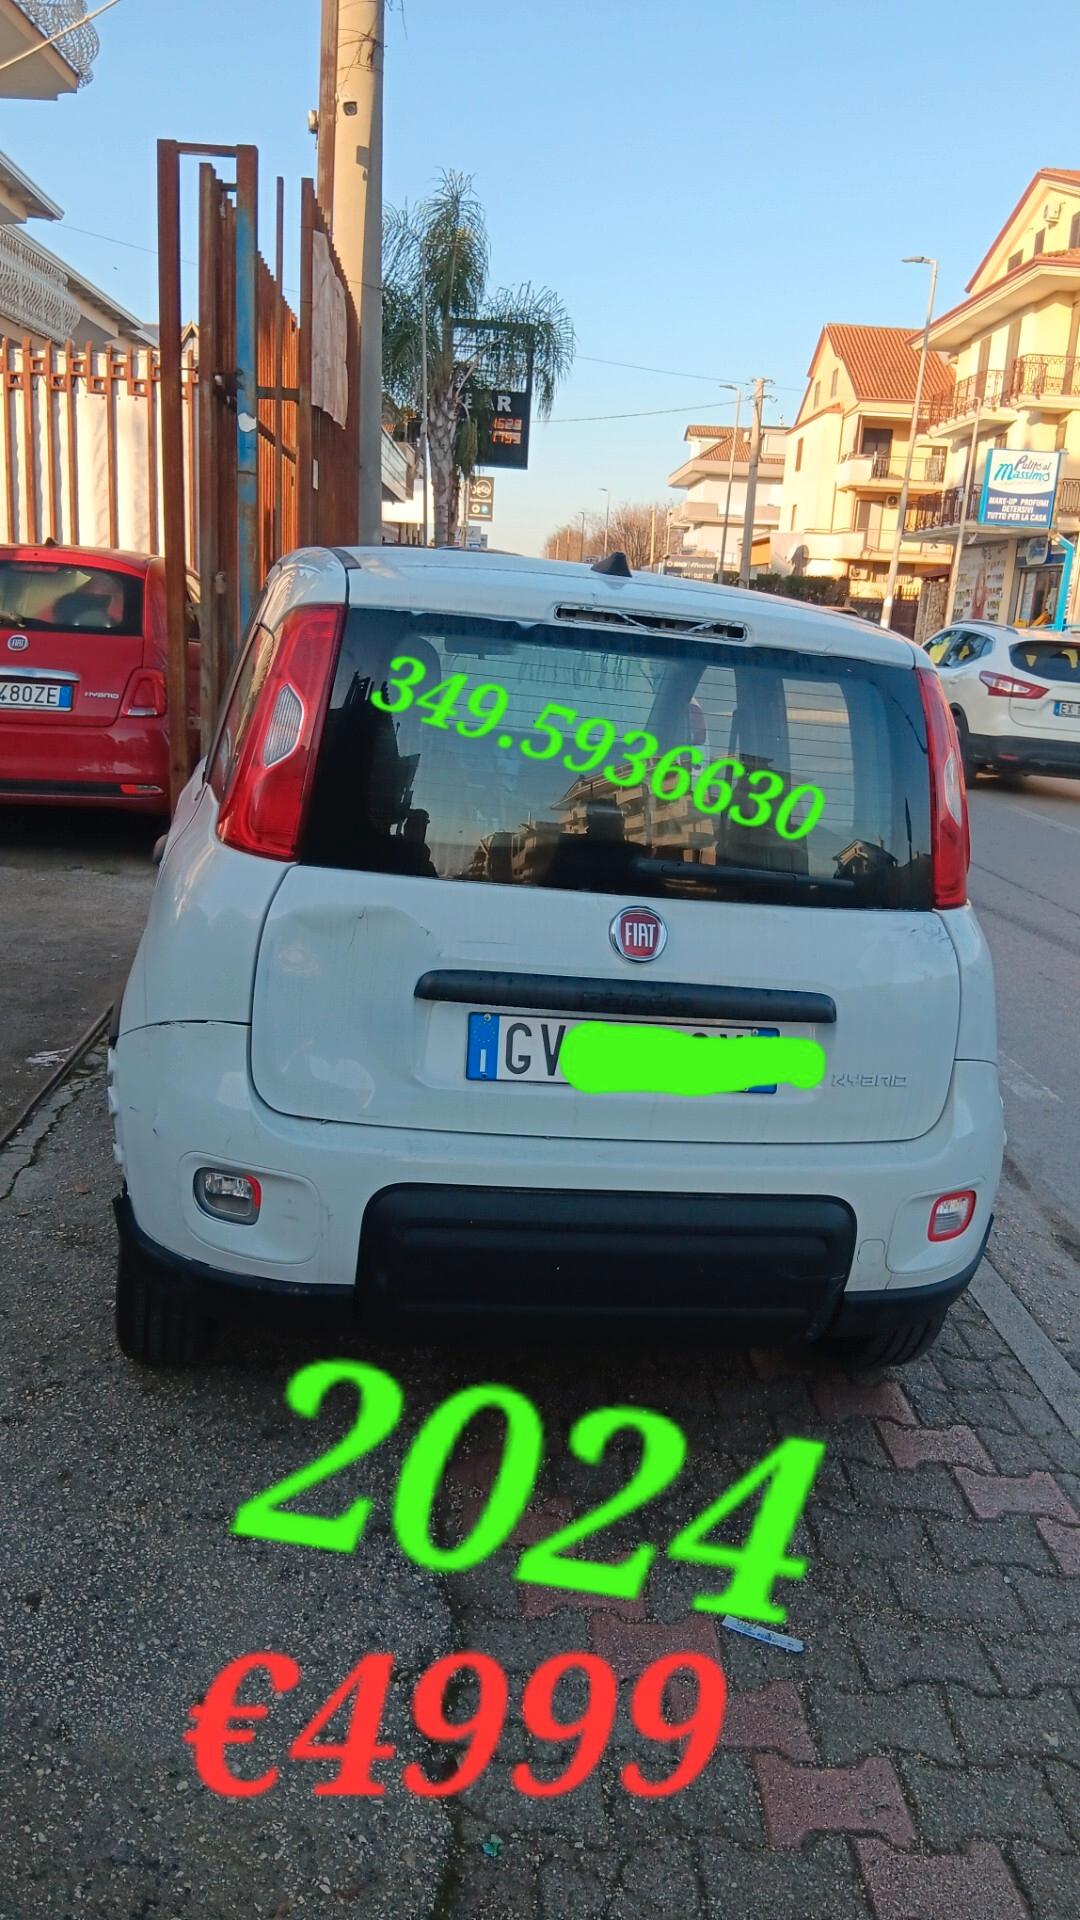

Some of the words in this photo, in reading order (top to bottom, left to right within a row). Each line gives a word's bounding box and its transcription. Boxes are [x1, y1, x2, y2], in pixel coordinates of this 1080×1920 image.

[1014, 455, 1042, 472] Pulito
[994, 463, 1050, 482] Massimo
[989, 497, 1018, 505] MAKE-UP
[1020, 498, 1050, 507] PROFUMI
[987, 511, 1007, 520] TUTTO
[1007, 513, 1020, 521] PER
[1021, 513, 1031, 521] LA
[1030, 514, 1047, 522] CASA
[1002, 505, 1034, 514] DETERSIVI
[625, 921, 656, 948] FIAT
